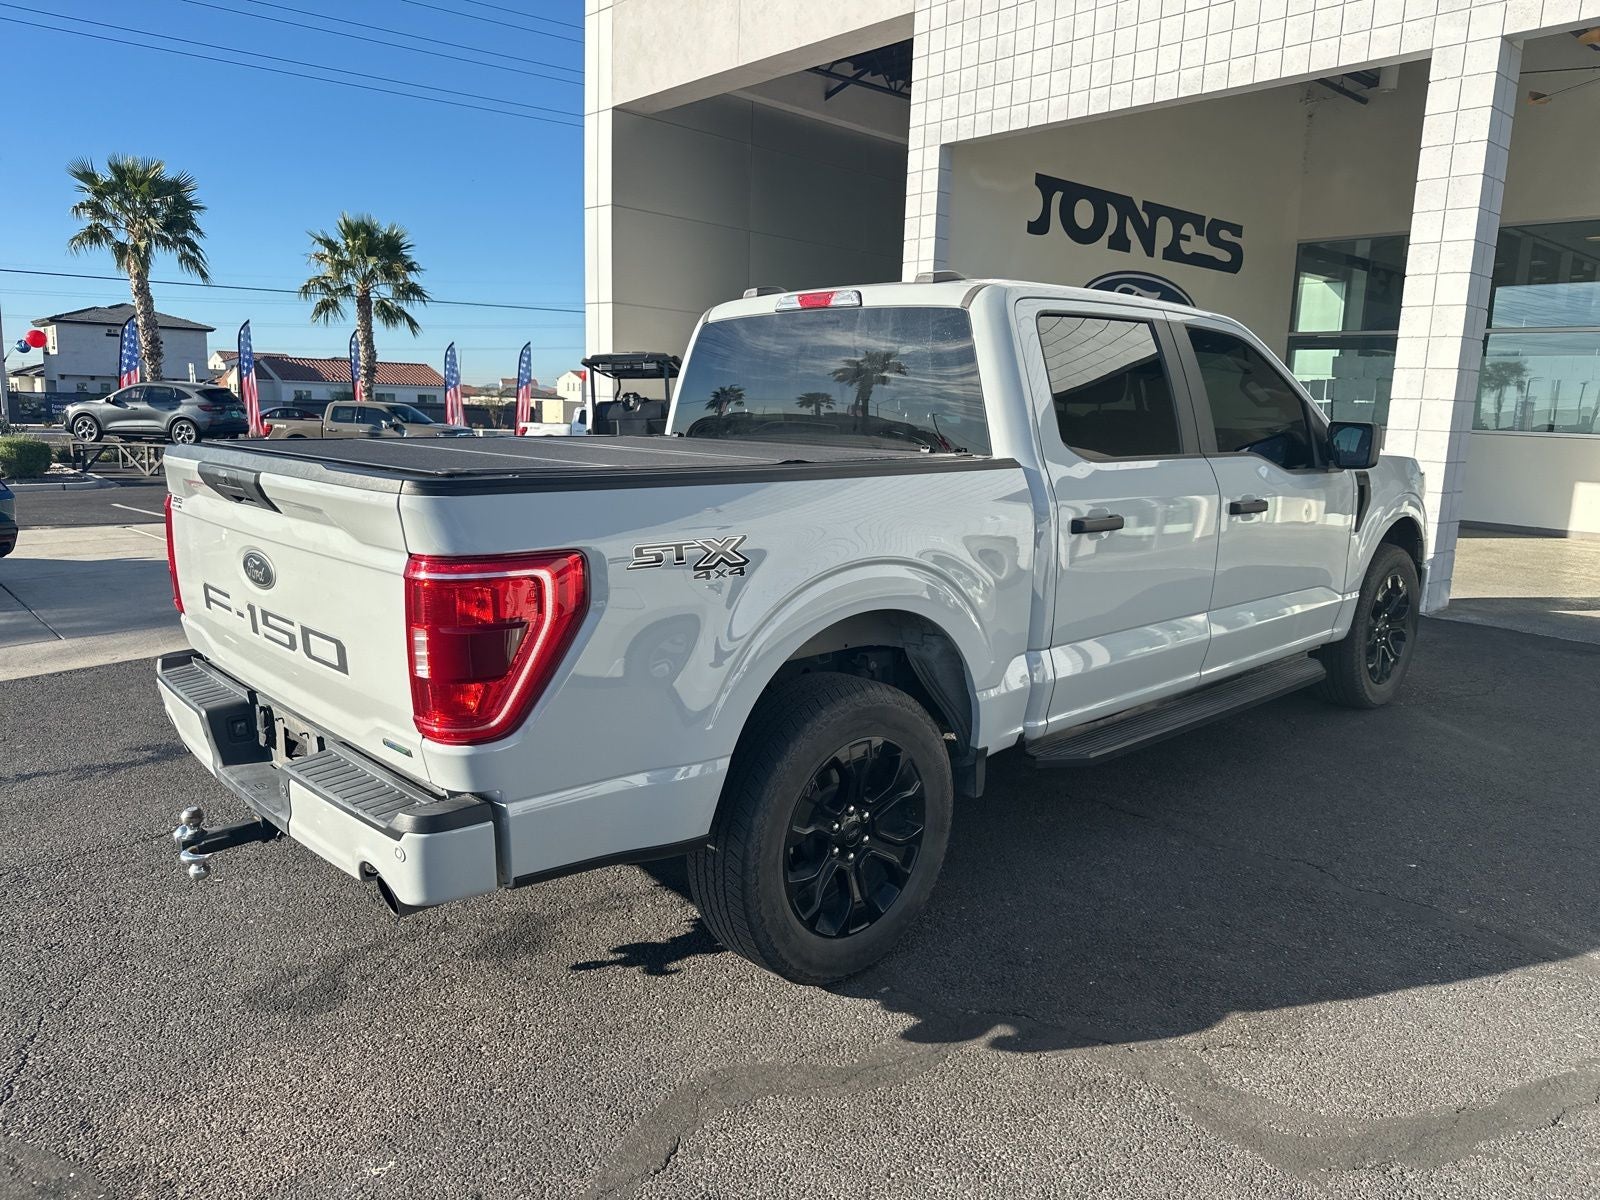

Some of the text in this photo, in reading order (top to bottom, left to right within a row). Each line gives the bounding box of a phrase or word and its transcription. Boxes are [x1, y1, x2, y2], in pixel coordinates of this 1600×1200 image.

[1027, 172, 1244, 274] JONES
[626, 534, 750, 571] STX
[203, 582, 350, 676] F-150
